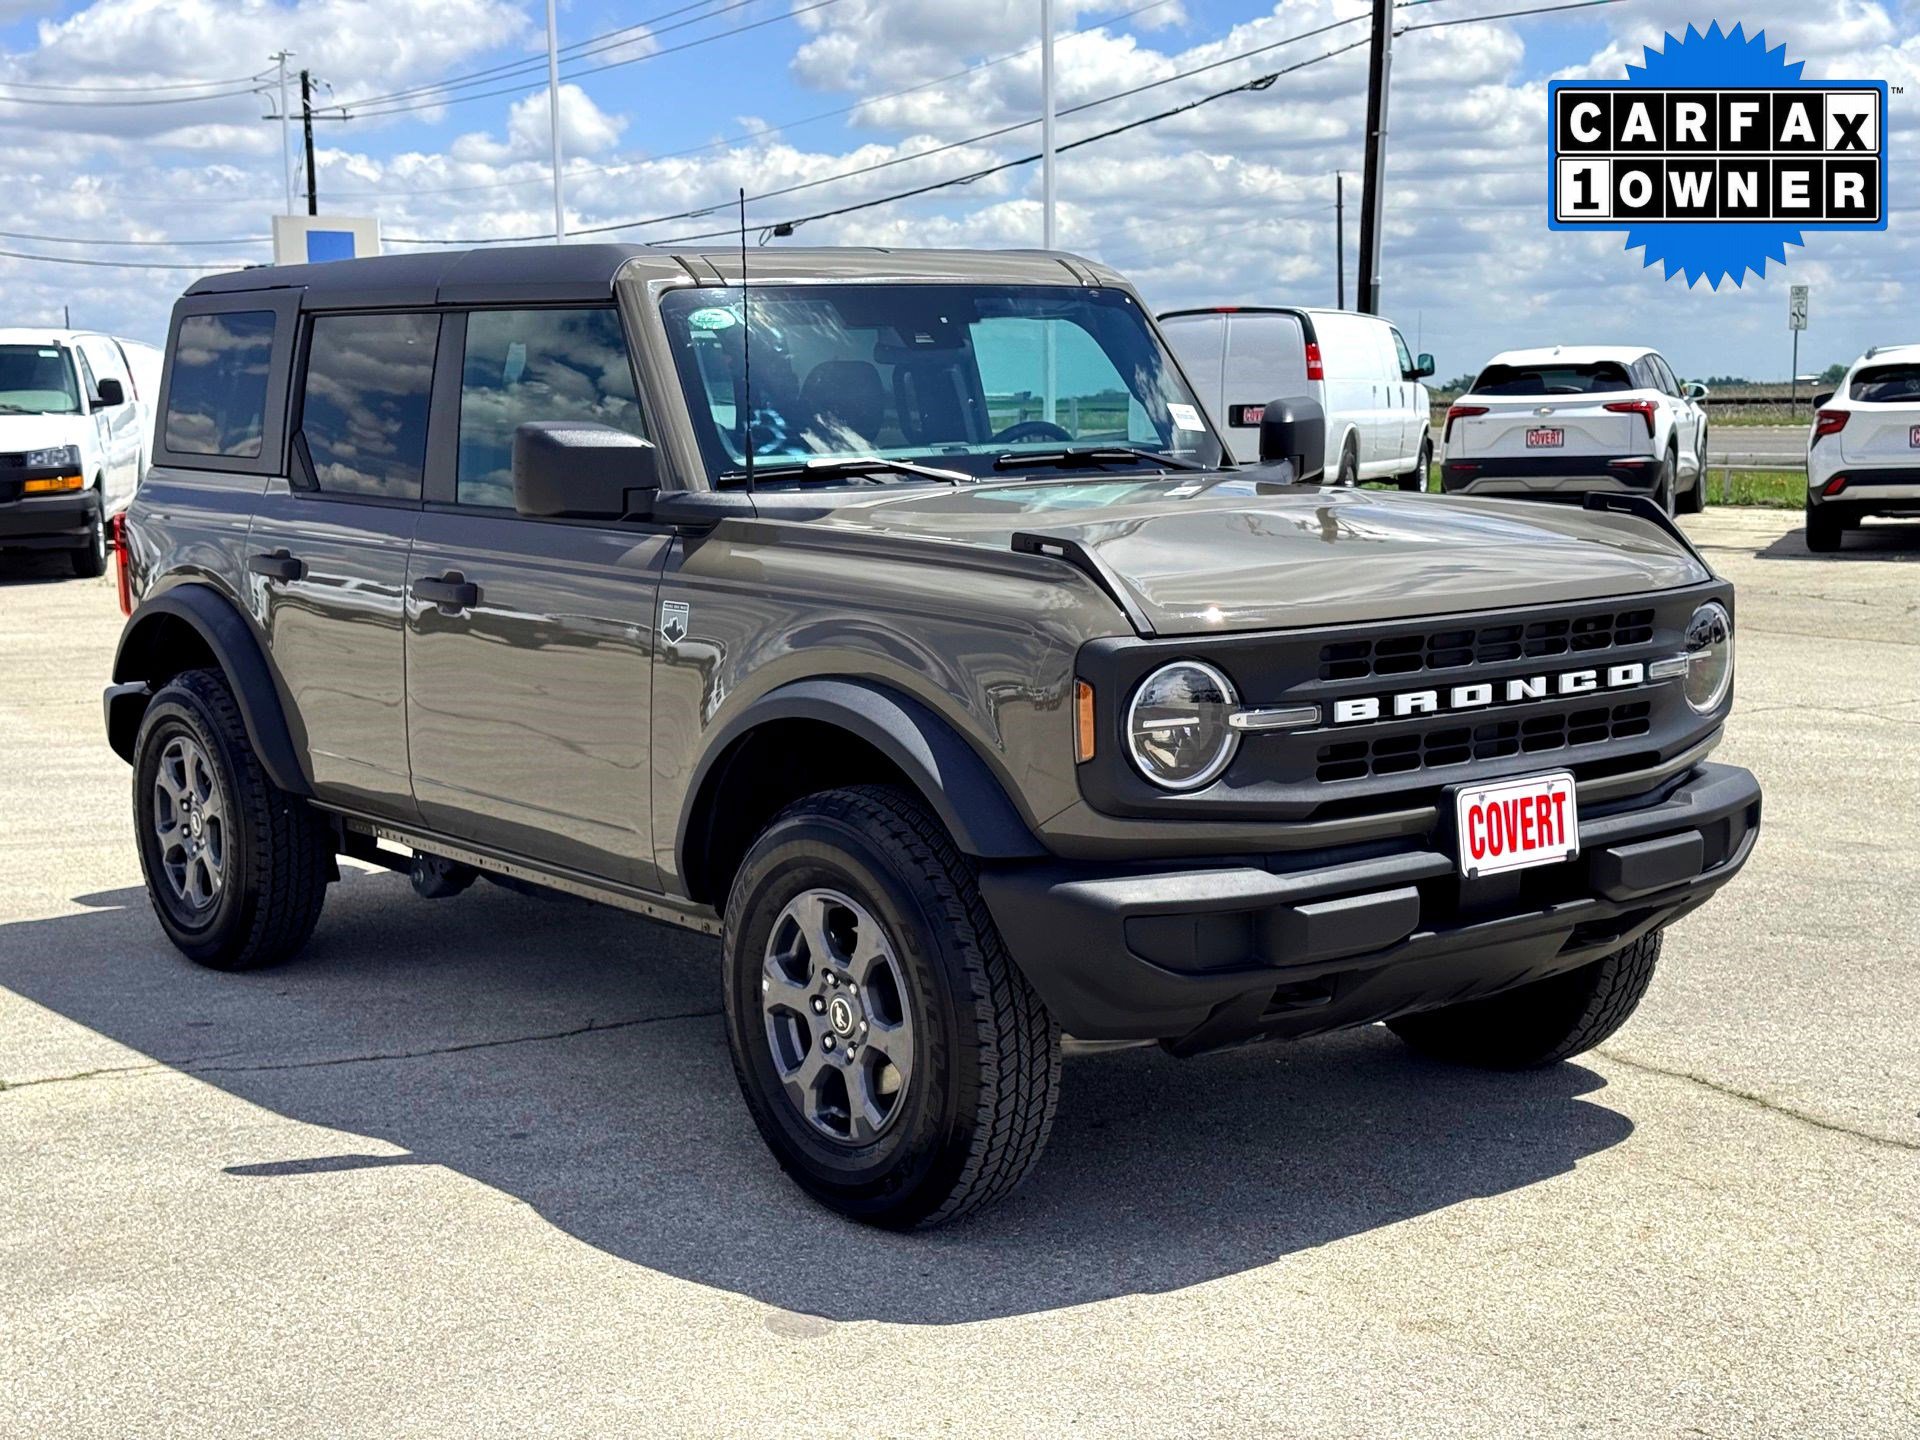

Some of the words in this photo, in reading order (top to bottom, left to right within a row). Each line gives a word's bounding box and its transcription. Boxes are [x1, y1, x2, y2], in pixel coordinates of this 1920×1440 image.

[1529, 431, 1560, 445] COVERT
[1334, 663, 1645, 723] BRONCO
[1468, 791, 1566, 860] COVERT
